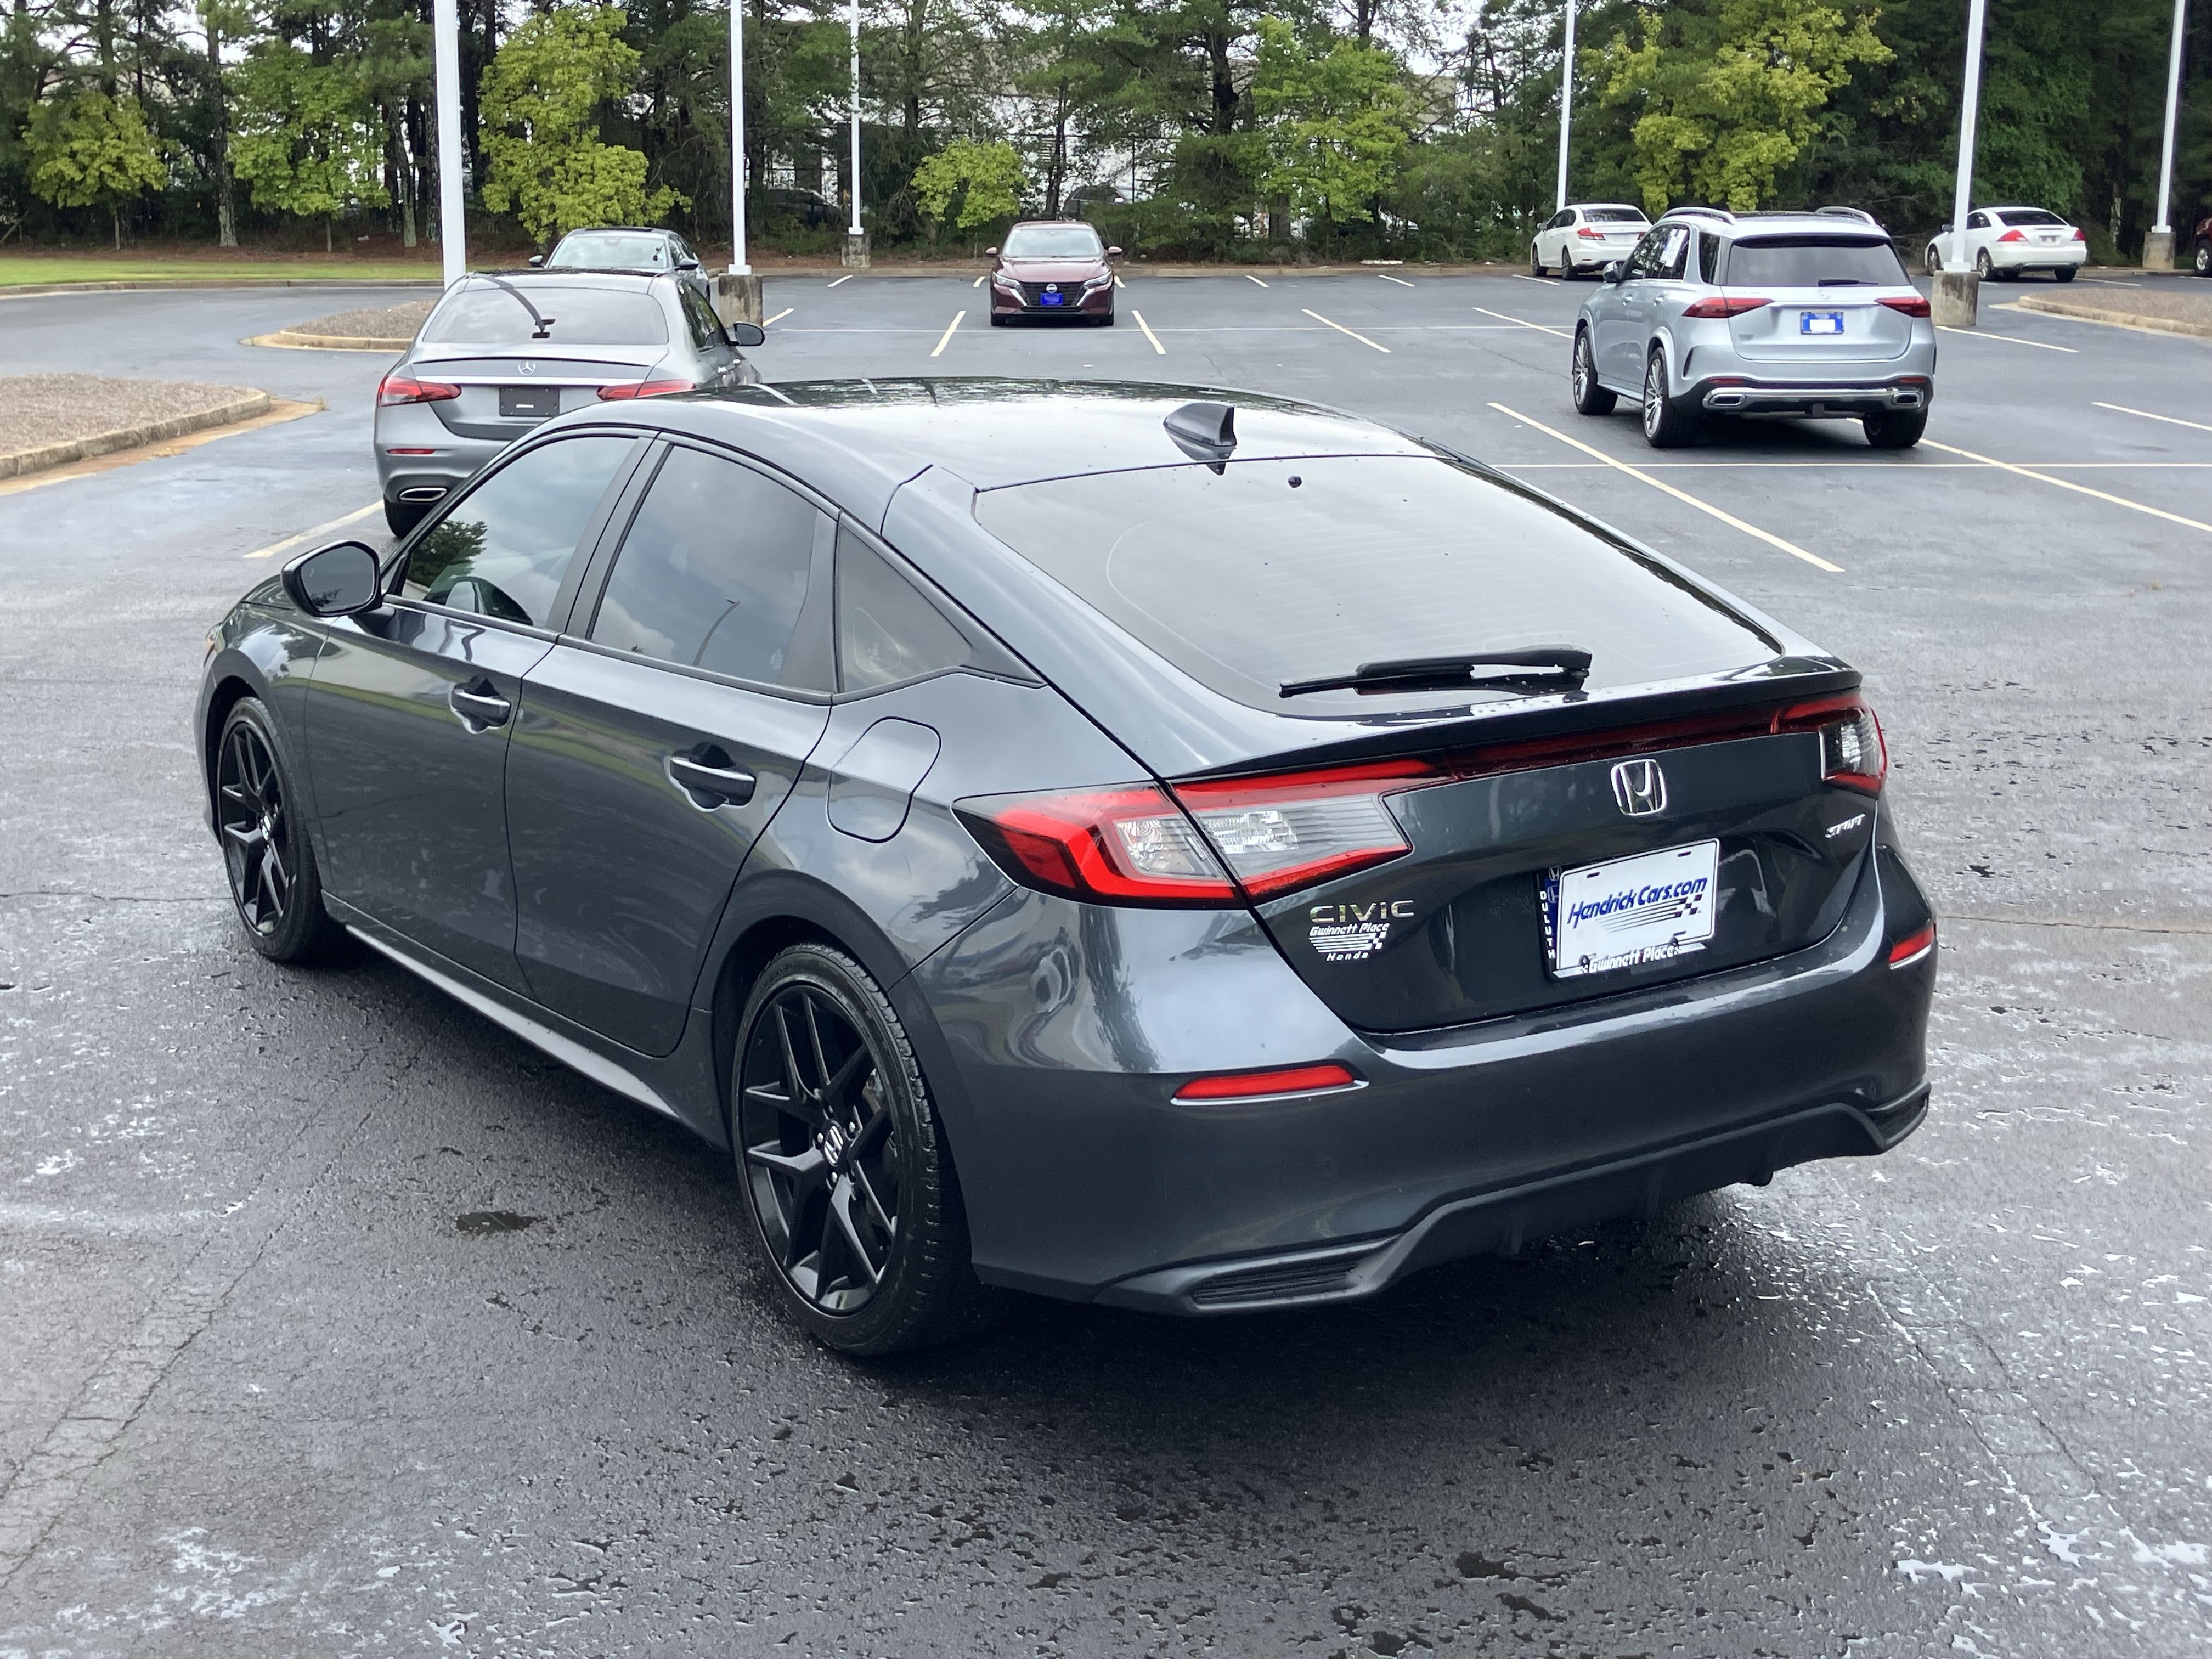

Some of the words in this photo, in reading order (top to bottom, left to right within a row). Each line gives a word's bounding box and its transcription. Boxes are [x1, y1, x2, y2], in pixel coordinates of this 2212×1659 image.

[1310, 900, 1415, 923] CIVIC
[1567, 888, 1637, 929] Hendrick
[1637, 878, 1707, 906] Cars.com
[1309, 923, 1358, 936] Gwinnett
[1359, 923, 1390, 933] Place
[1539, 891, 1556, 959] DULUTH
[1326, 951, 1369, 961] Honda
[1589, 950, 1640, 973] Gwinnett
[1642, 945, 1674, 963] Place
